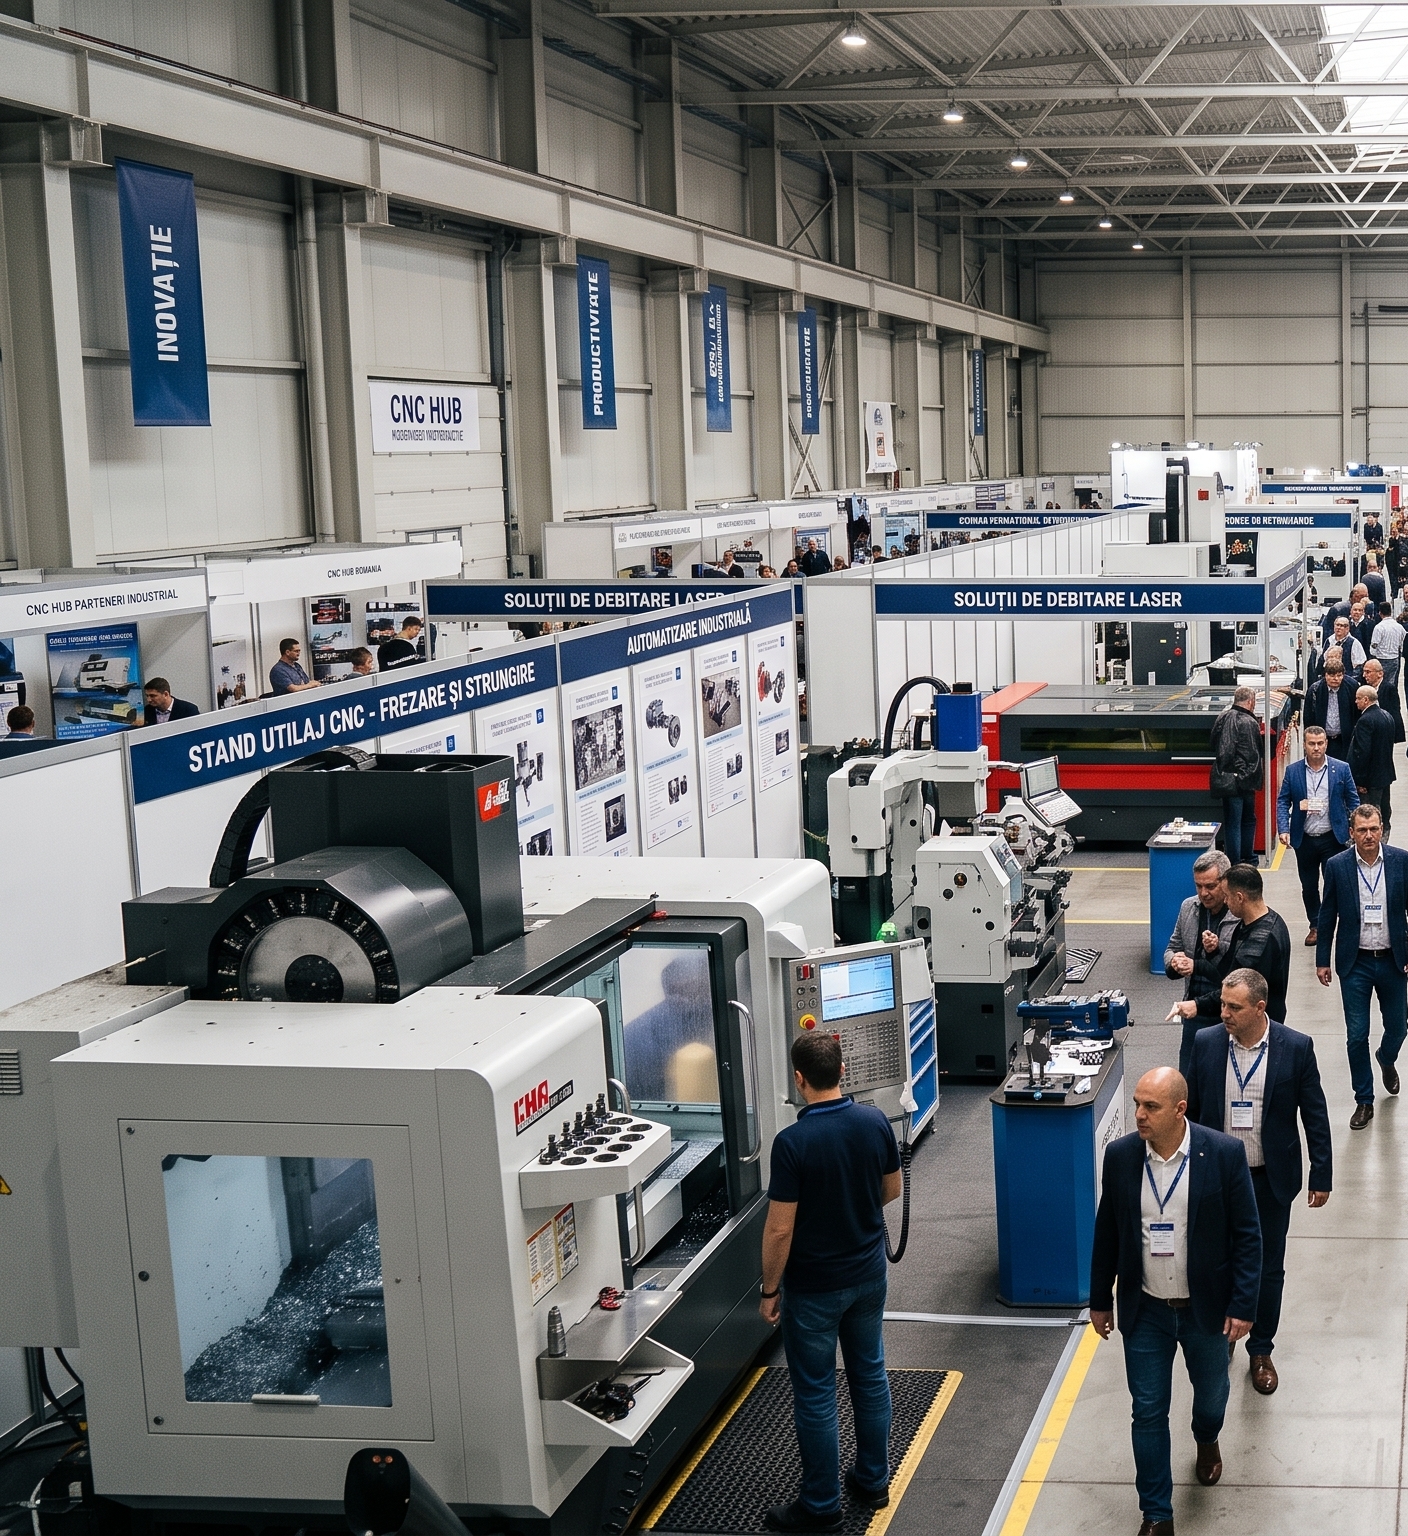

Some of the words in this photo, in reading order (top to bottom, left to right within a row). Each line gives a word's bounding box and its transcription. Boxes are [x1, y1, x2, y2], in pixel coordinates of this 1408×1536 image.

[390, 394, 425, 424] CNC
[430, 396, 462, 425] HUB
[327, 569, 341, 578] CNC
[26, 602, 50, 617] CNC
[51, 600, 74, 615] HUB
[75, 594, 127, 612] PARTENERI
[128, 588, 179, 607] INDUSTRIAL
[504, 591, 567, 612] SOLUȚII
[571, 592, 591, 608] DE
[594, 592, 670, 608] DEBITARE
[675, 592, 725, 606] LAS
[953, 590, 1018, 612] SOLUȚII
[1022, 591, 1043, 607] DE
[1047, 591, 1126, 607] DEBITARE
[1130, 591, 1183, 607] LASER
[627, 620, 698, 656] AUTOMATIZARE
[188, 739, 257, 773] STAND
[261, 713, 326, 754] UTILAJ
[329, 704, 365, 735] CNC
[379, 683, 447, 722] FREZARE
[464, 661, 536, 700] STRUNGIRE
